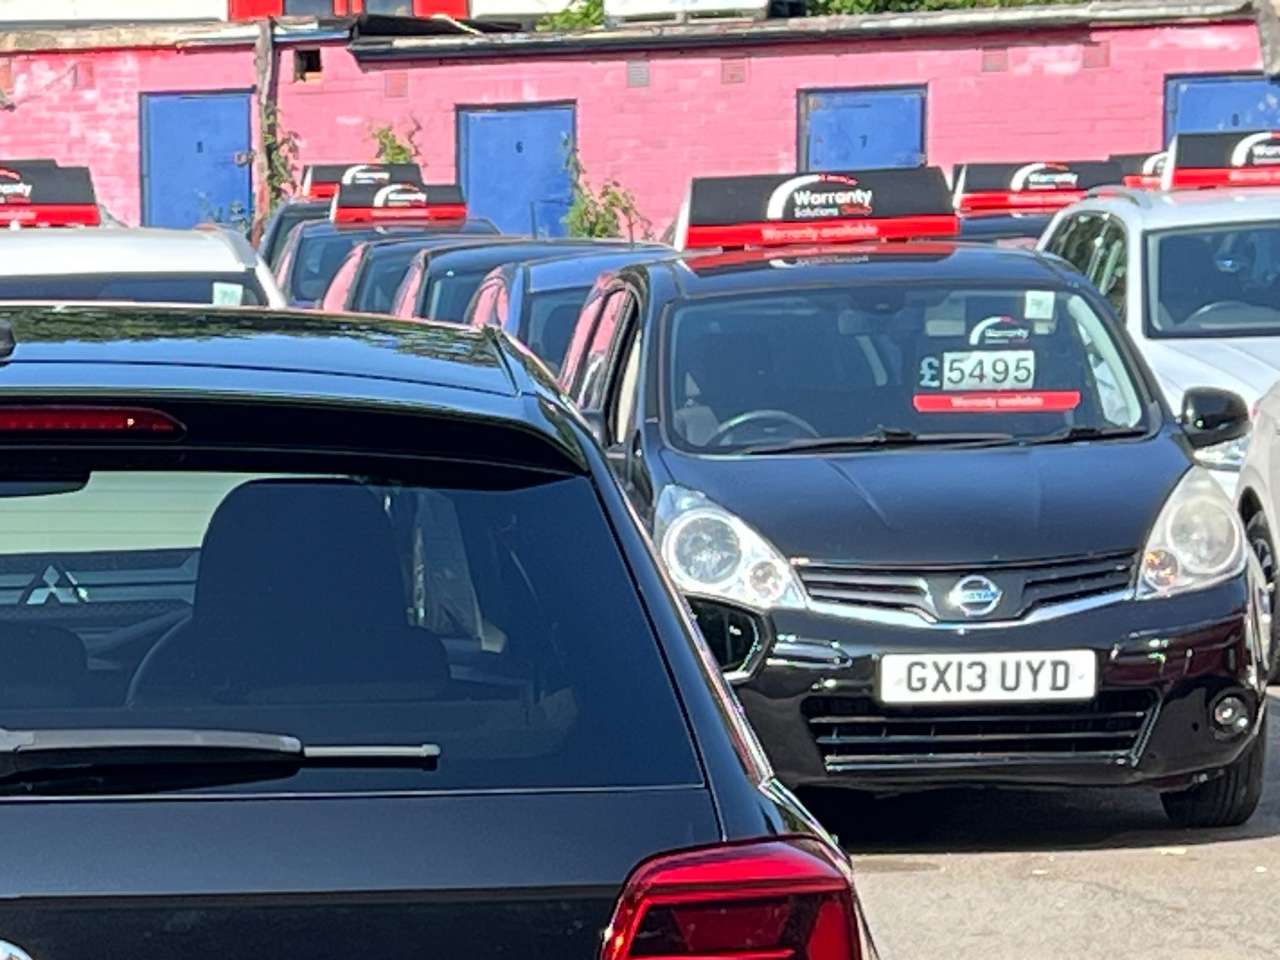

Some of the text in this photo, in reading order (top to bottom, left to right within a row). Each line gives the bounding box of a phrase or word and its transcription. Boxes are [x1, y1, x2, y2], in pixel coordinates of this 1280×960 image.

[794, 188, 873, 210] Warranty
[906, 659, 1070, 693] GX13 UYD
